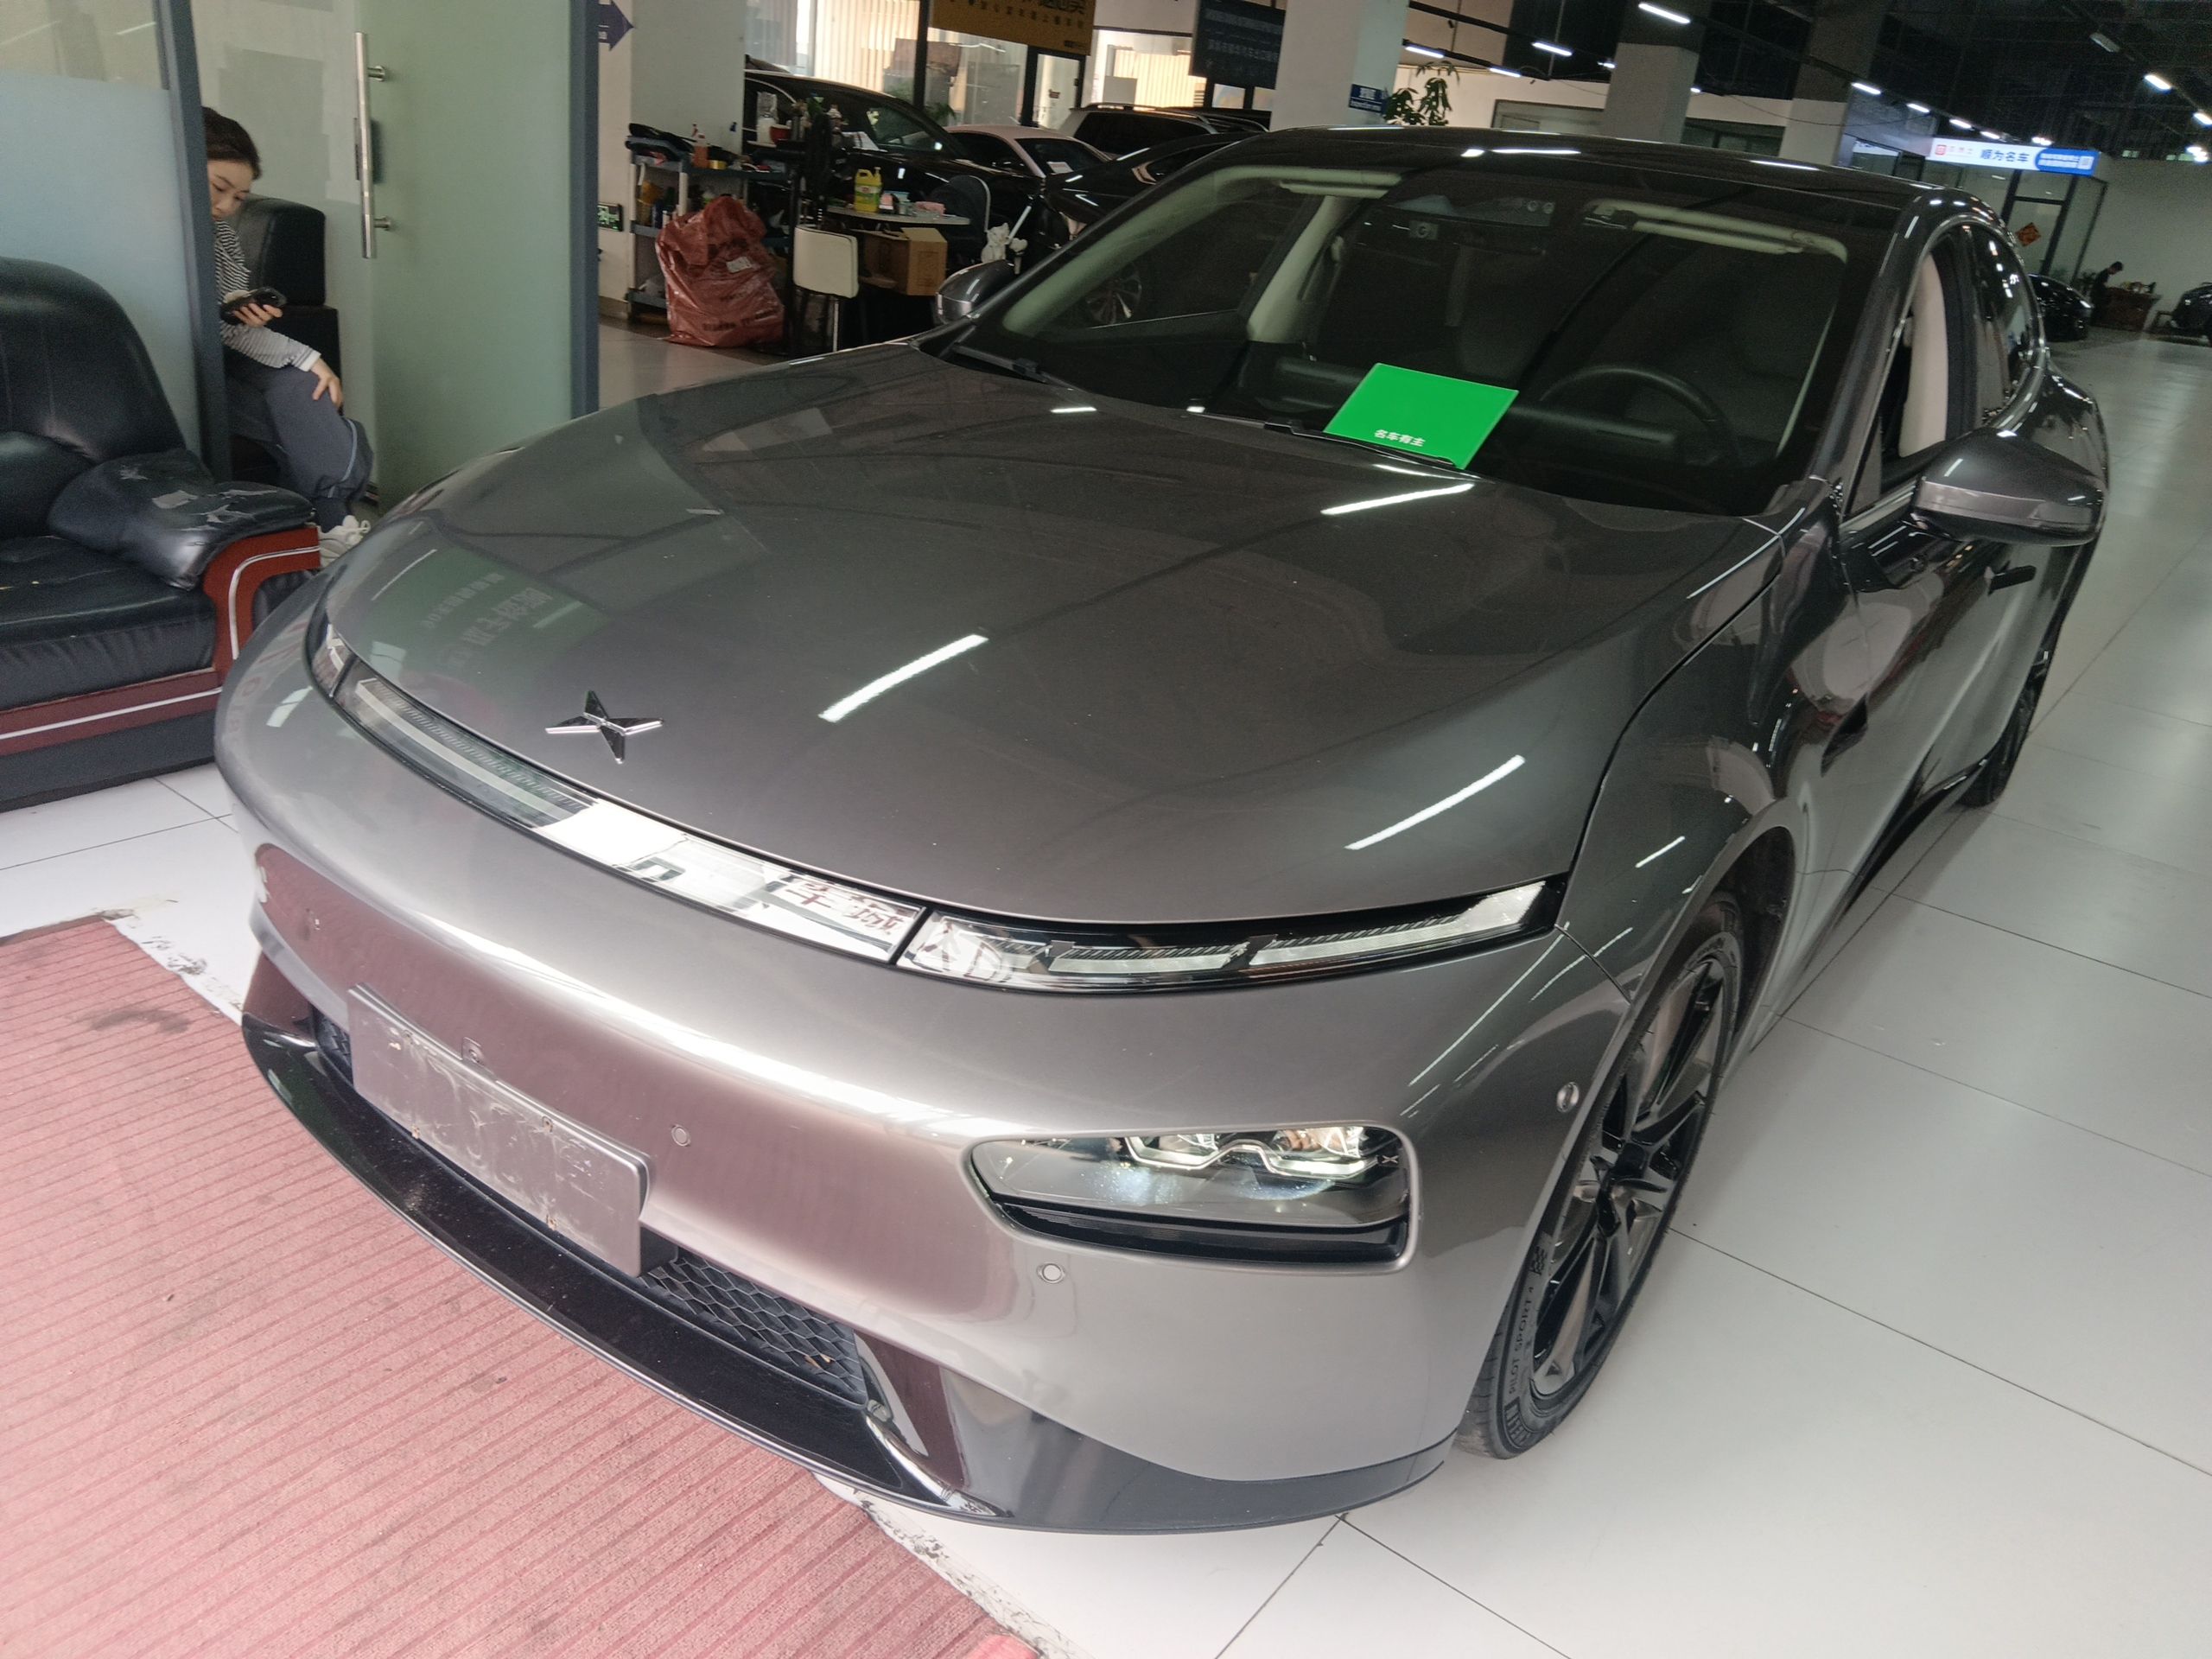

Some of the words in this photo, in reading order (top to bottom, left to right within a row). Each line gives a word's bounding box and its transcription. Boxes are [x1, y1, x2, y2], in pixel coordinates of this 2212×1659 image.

[1374, 429, 1426, 447] 名车有主
[1515, 1300, 1532, 1351] SPORT
